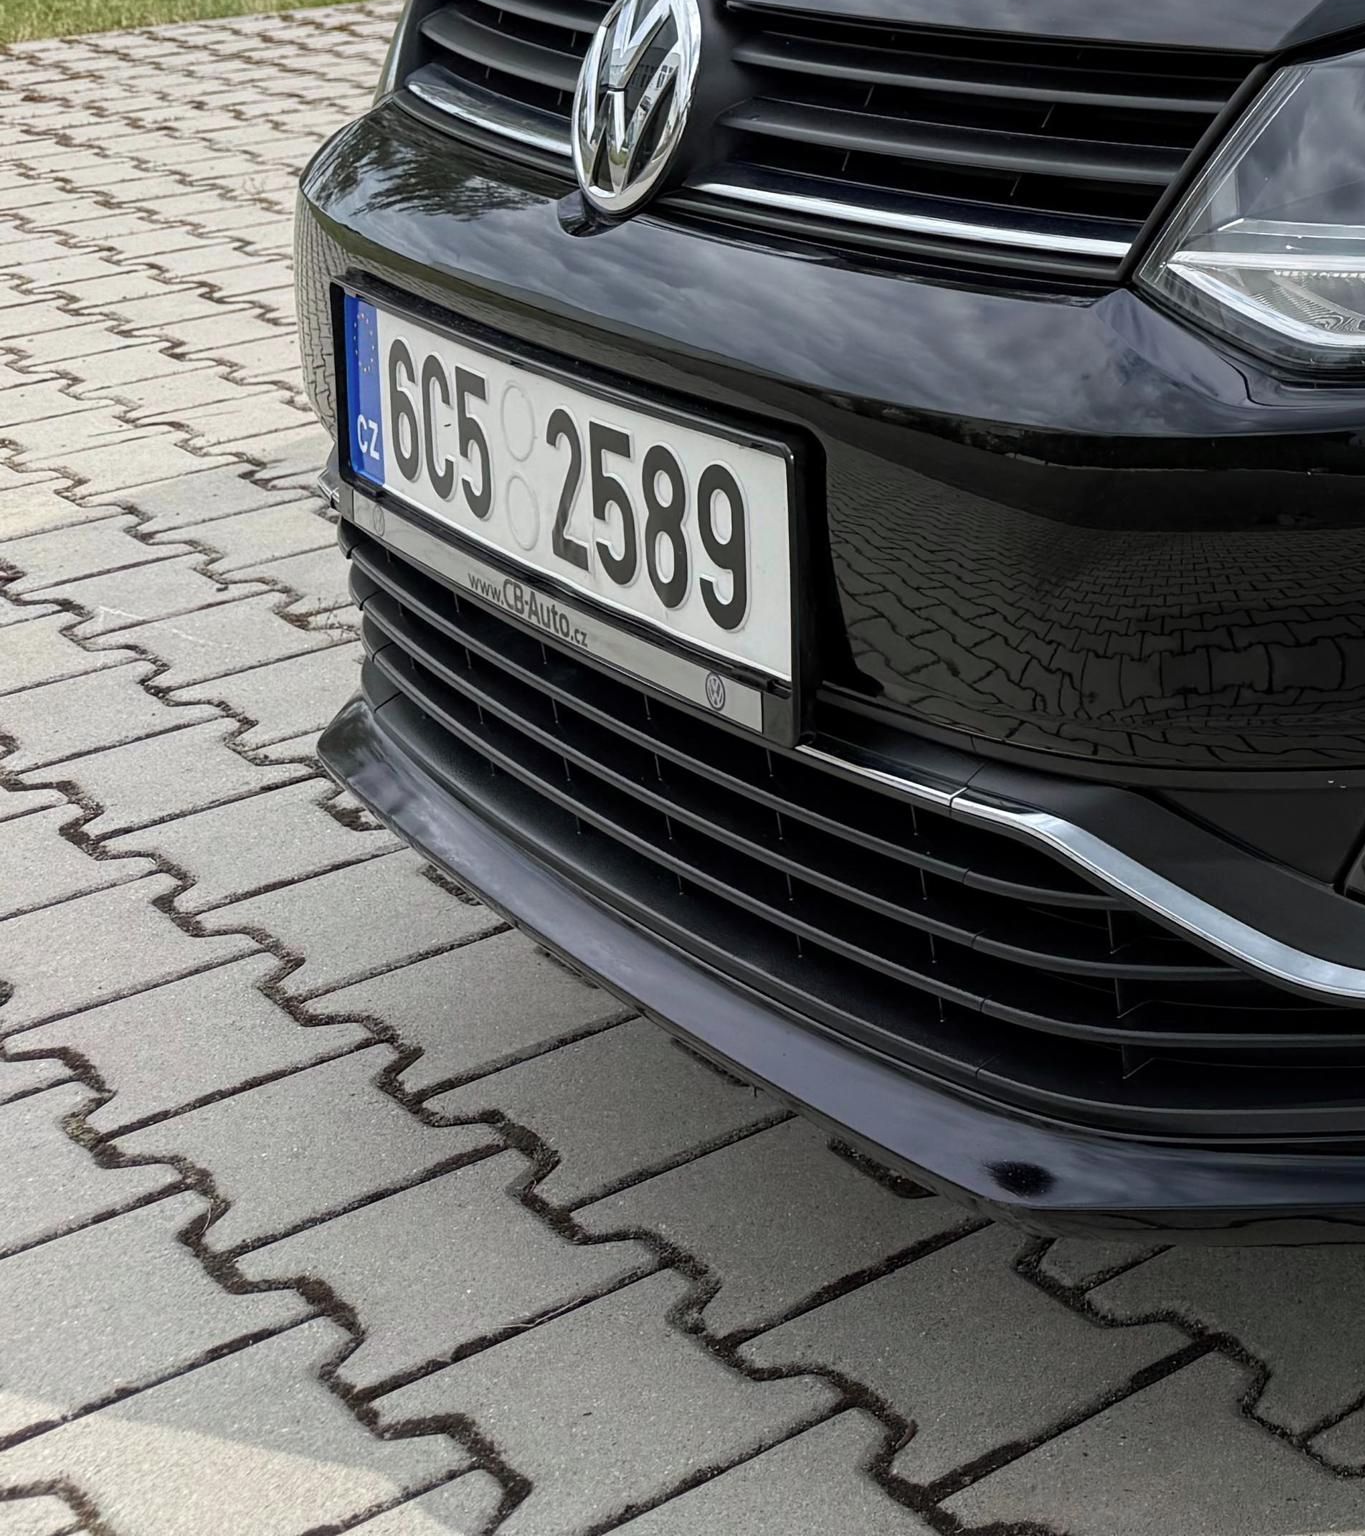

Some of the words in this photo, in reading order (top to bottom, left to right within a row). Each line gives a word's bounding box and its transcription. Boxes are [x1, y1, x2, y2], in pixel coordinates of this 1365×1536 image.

[356, 413, 381, 461] CZ
[388, 337, 492, 521] 6C5
[545, 407, 749, 632] 2589
[467, 572, 589, 649] www.CB-Auto.cz
